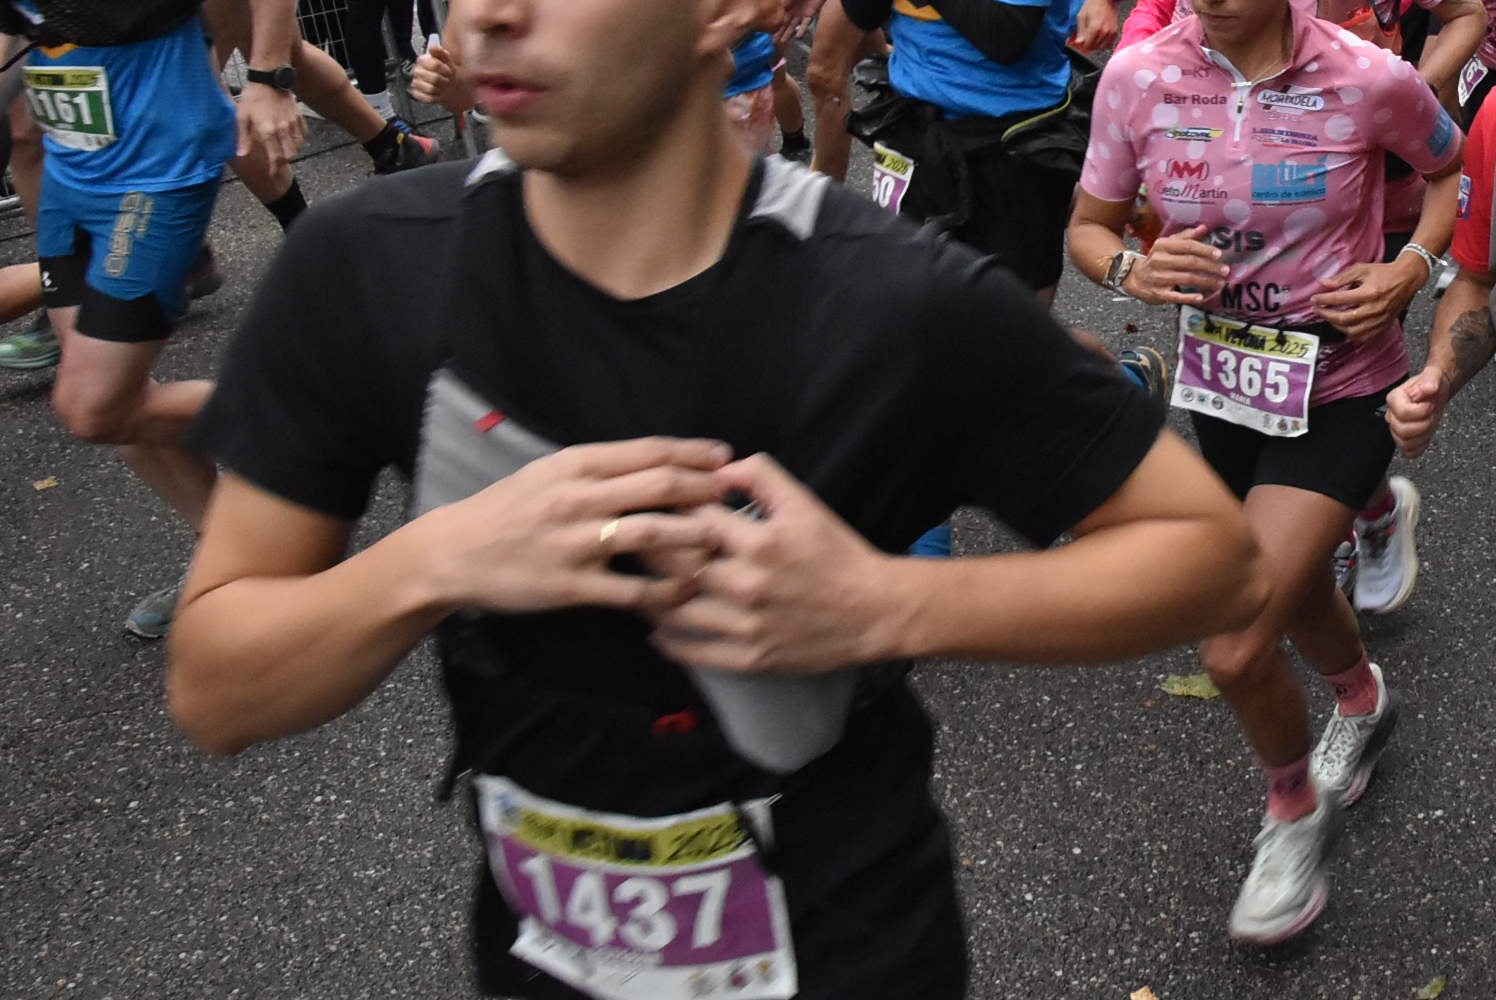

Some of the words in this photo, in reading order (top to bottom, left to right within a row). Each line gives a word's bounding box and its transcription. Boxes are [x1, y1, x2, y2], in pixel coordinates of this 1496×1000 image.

[1163, 93, 1187, 105] Bar
[1192, 93, 1227, 105] Roda
[1213, 226, 1265, 252] SIS
[1221, 281, 1281, 313] MSC
[1269, 337, 1311, 358] 2025
[1195, 343, 1291, 404] 1365
[517, 851, 732, 953] 1437
